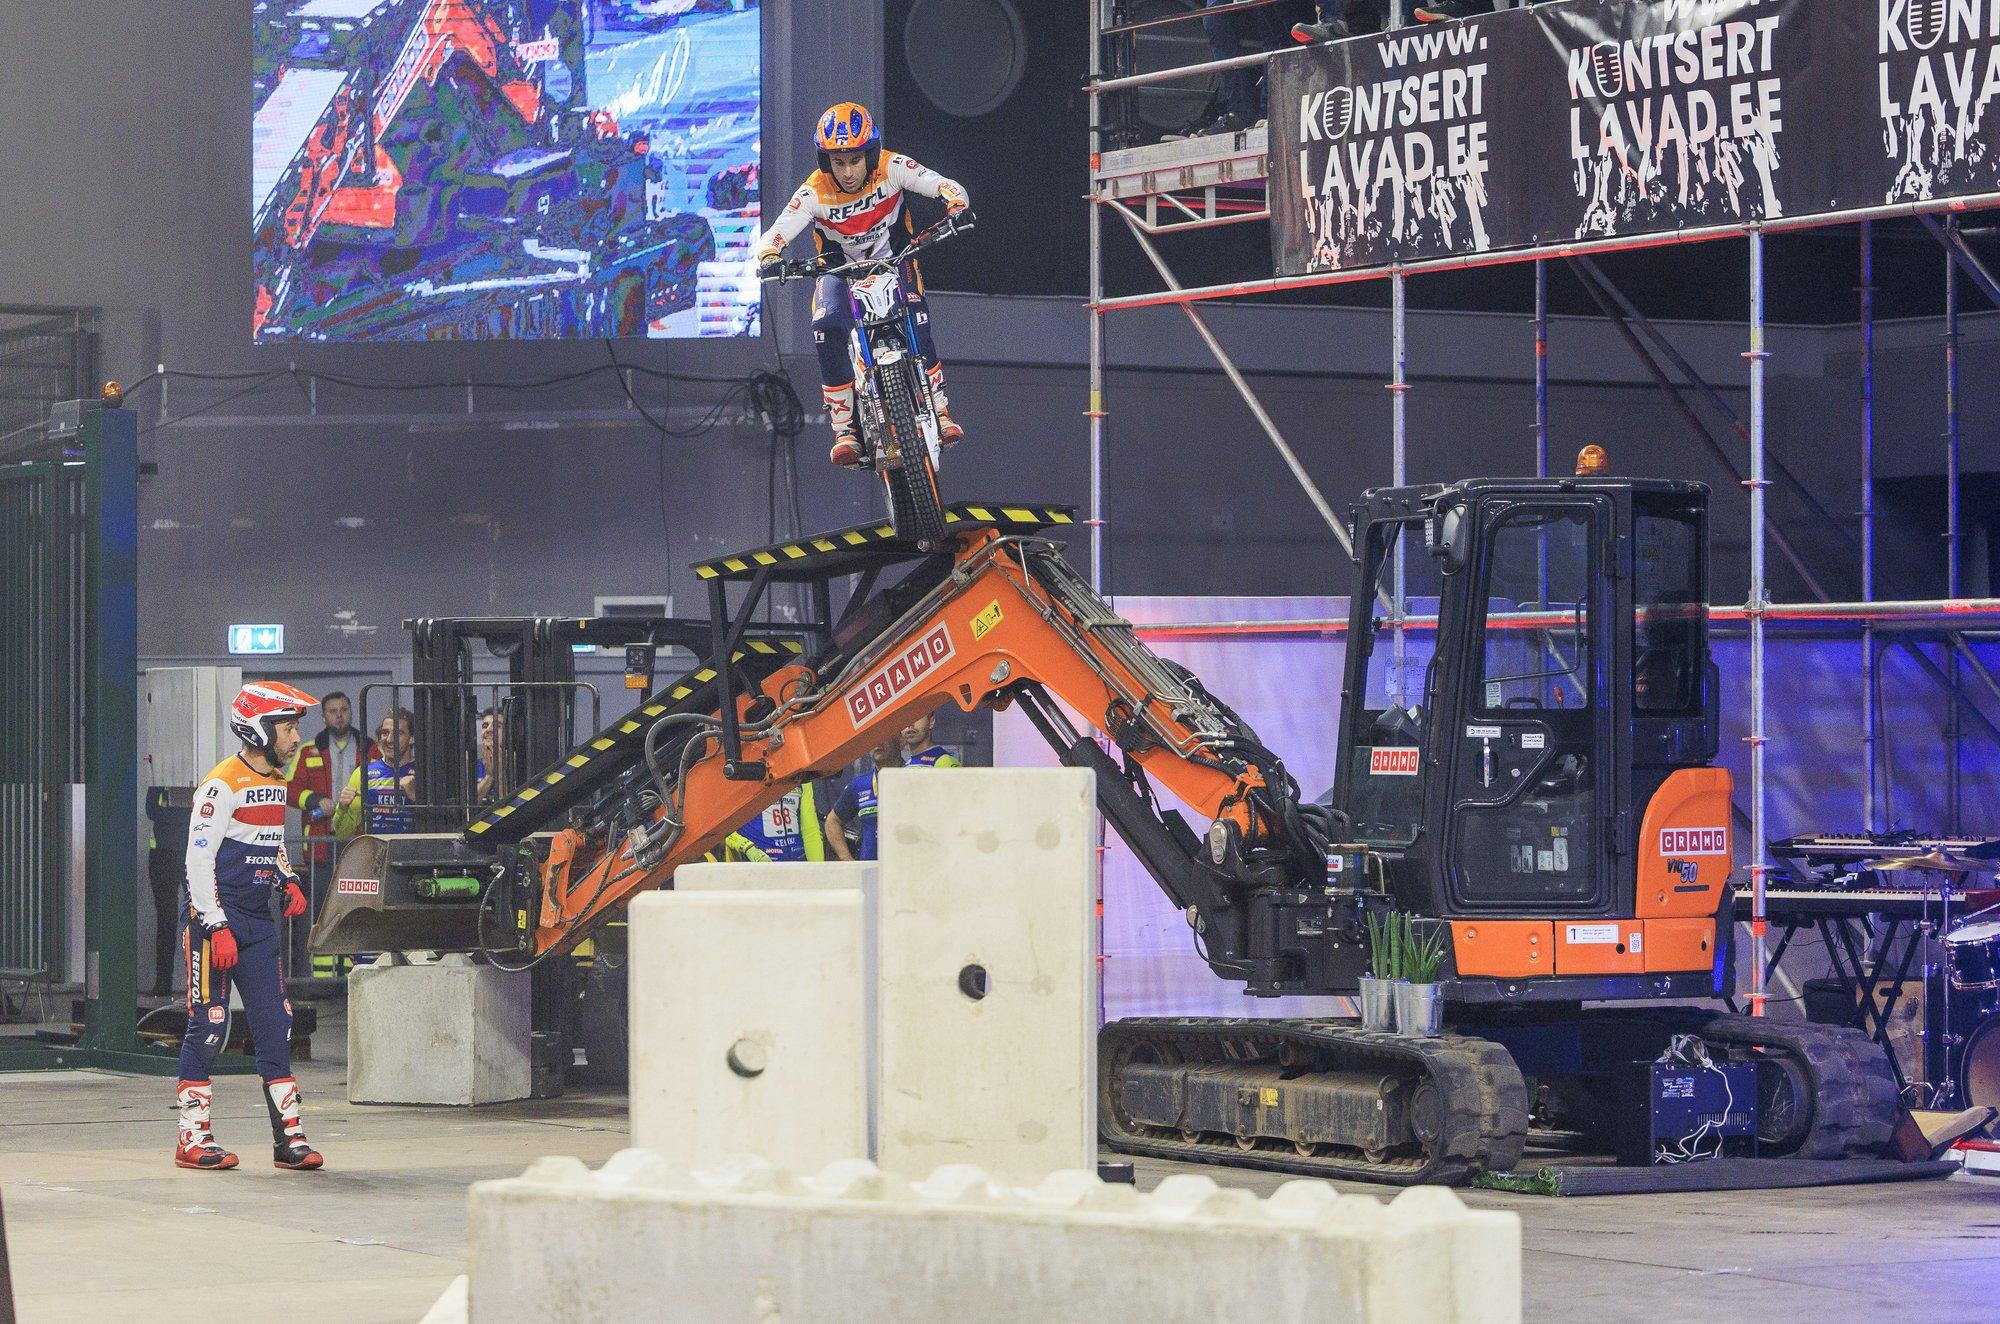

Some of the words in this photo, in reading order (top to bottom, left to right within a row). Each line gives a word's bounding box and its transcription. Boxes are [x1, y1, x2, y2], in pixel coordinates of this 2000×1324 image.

[1568, 15, 1780, 100] KONTSERT
[1300, 62, 1488, 143] KONTSERT
[1570, 77, 1783, 161] LAVAD.EE
[1300, 121, 1489, 199] LAVAD.EE
[828, 186, 887, 221] REPSL
[854, 636, 945, 714] CRAMO
[1373, 754, 1416, 767] CRAMO
[377, 794, 407, 806] KENY
[244, 855, 277, 865] HON
[1664, 833, 1723, 848] CRAMO
[340, 882, 377, 891] CRAMO
[192, 950, 202, 1004] REPSOL
